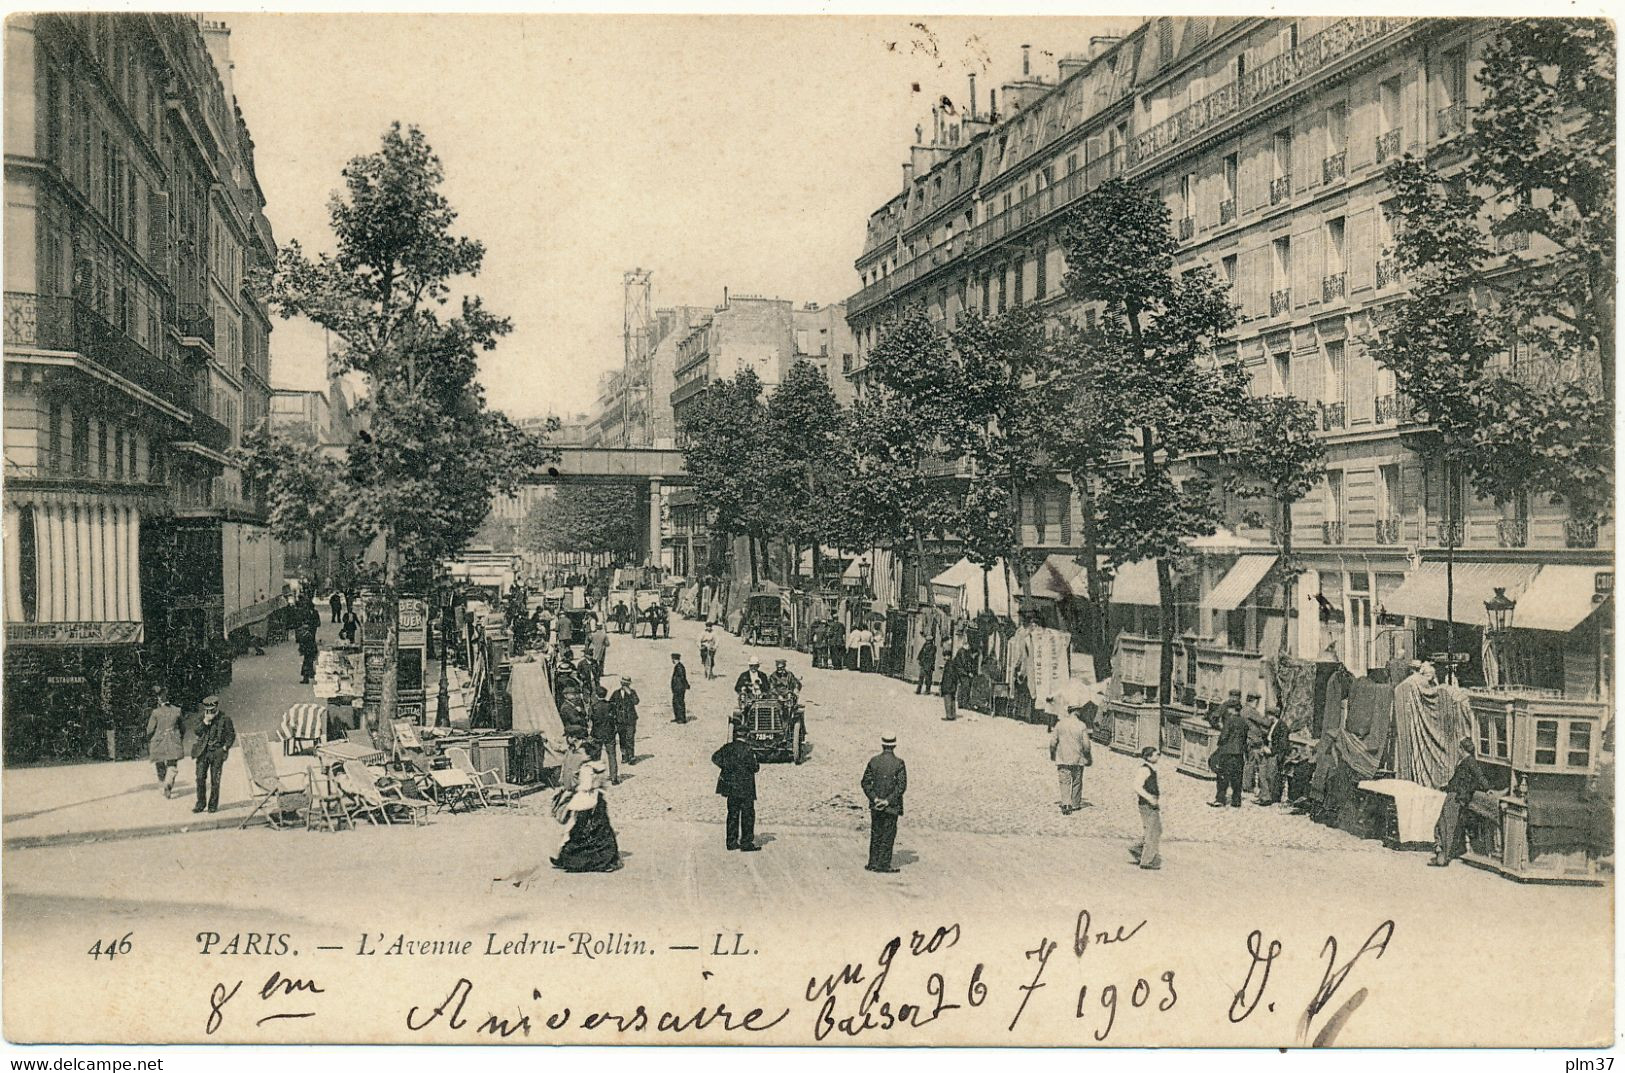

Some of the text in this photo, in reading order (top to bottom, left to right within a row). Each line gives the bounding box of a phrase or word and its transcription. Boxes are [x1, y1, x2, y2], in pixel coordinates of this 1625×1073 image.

[88, 932, 133, 960] 446
[196, 933, 760, 957] PARIS. L'Avenue Ledru-Rollin. LL.
